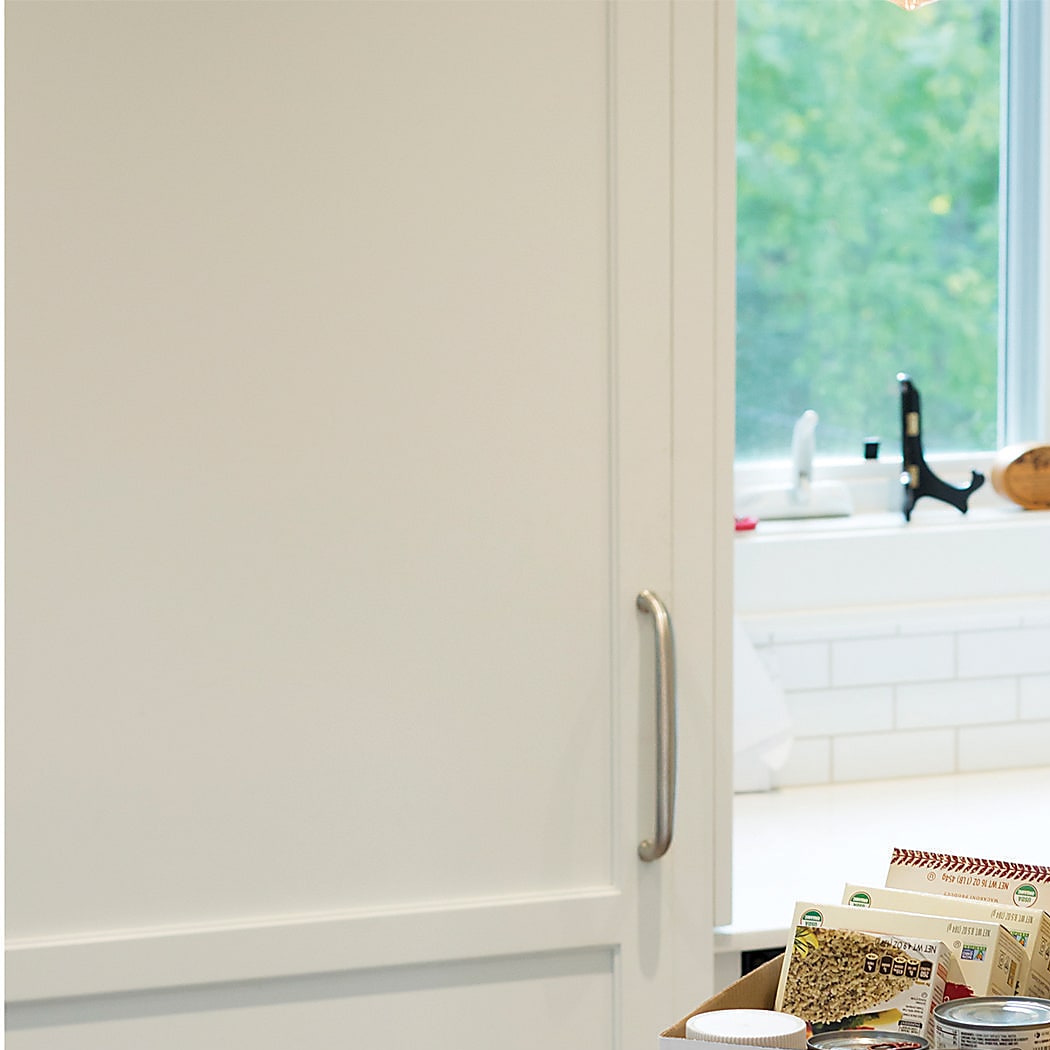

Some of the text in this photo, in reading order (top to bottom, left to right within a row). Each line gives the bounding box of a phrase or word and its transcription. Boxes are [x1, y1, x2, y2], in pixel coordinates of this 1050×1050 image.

[973, 878, 980, 886] OZ
[989, 880, 997, 888] WT
[998, 882, 1009, 890] NET
[913, 944, 923, 952] WT
[924, 945, 936, 954] NET
